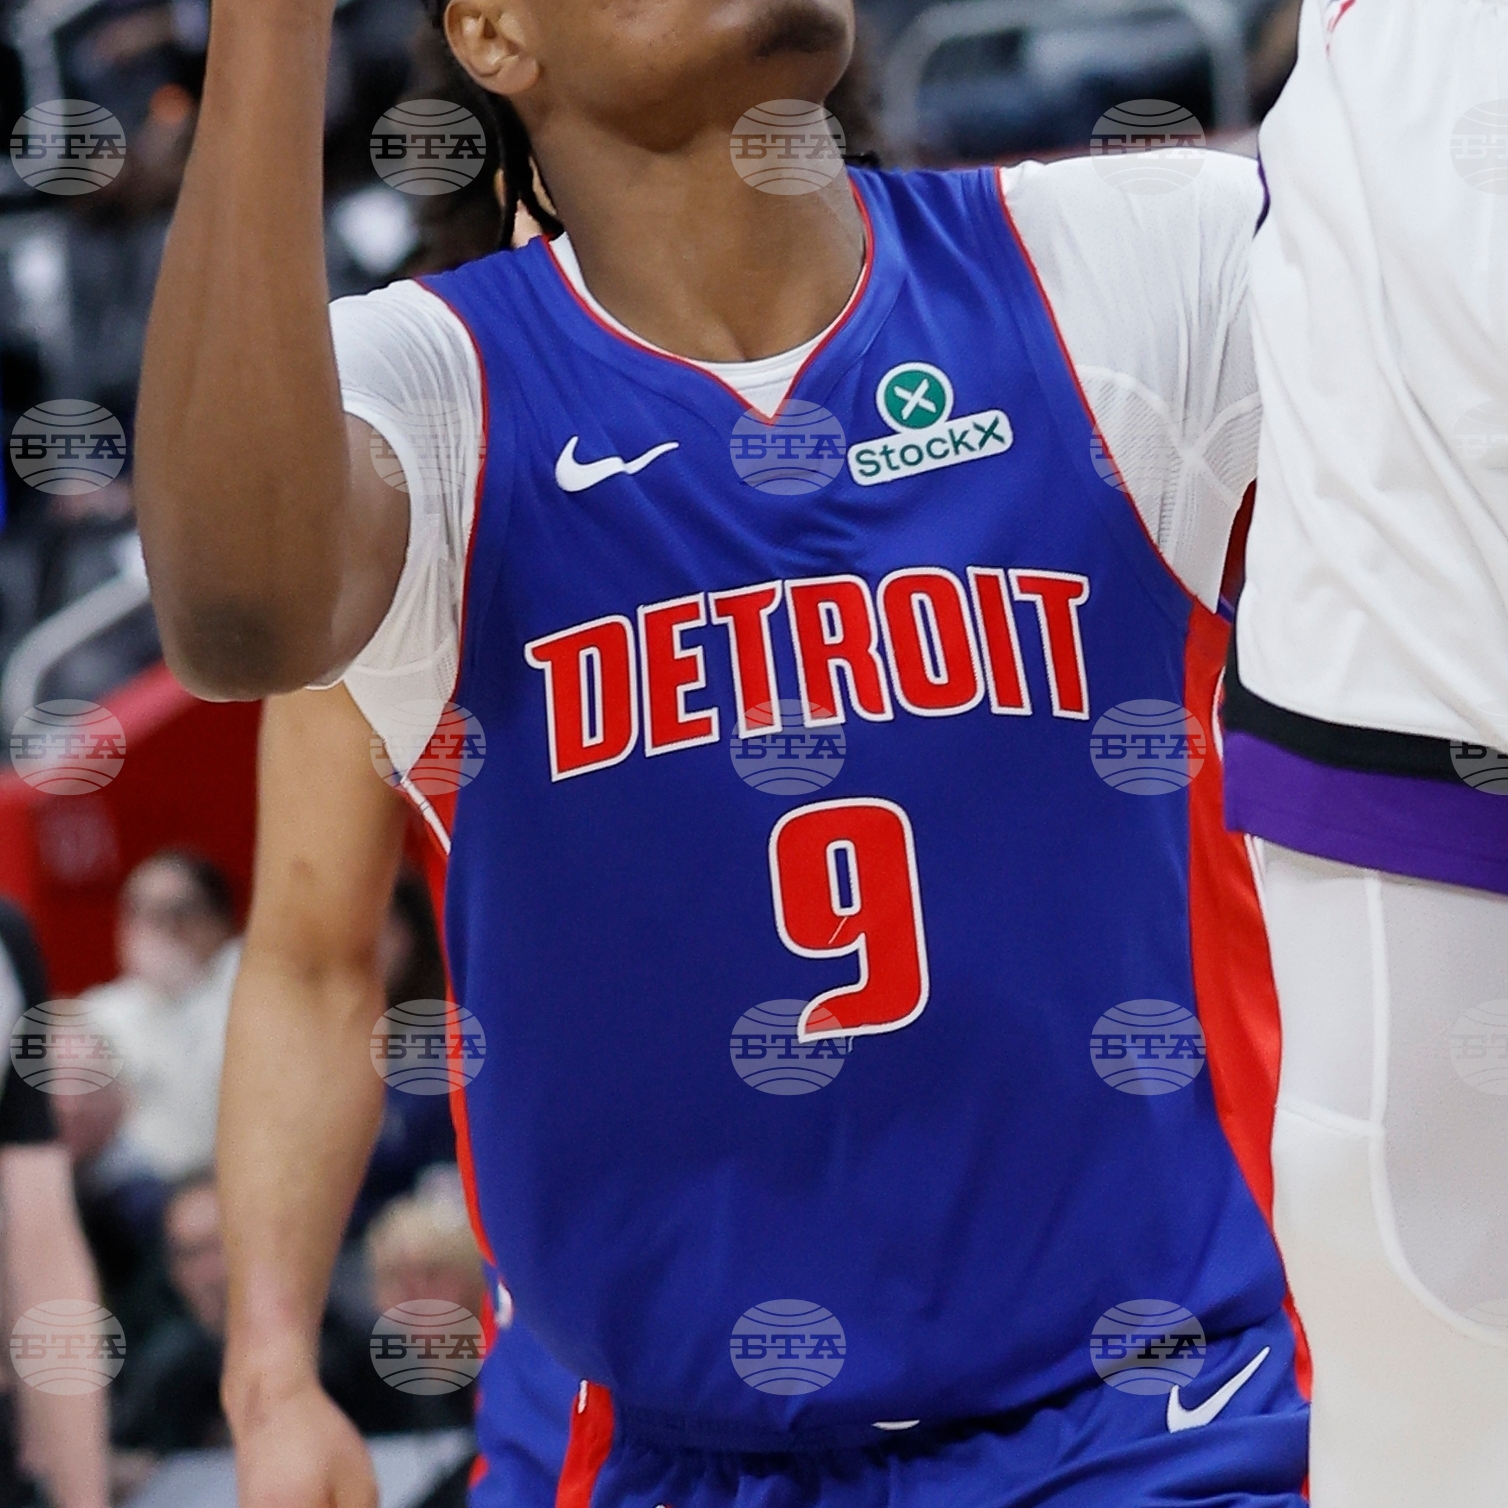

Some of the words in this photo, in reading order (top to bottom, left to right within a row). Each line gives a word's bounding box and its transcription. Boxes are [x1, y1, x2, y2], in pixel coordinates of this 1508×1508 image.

[854, 415, 1005, 478] StockX
[524, 565, 1092, 783] DETROIT
[768, 796, 929, 1044] 9
